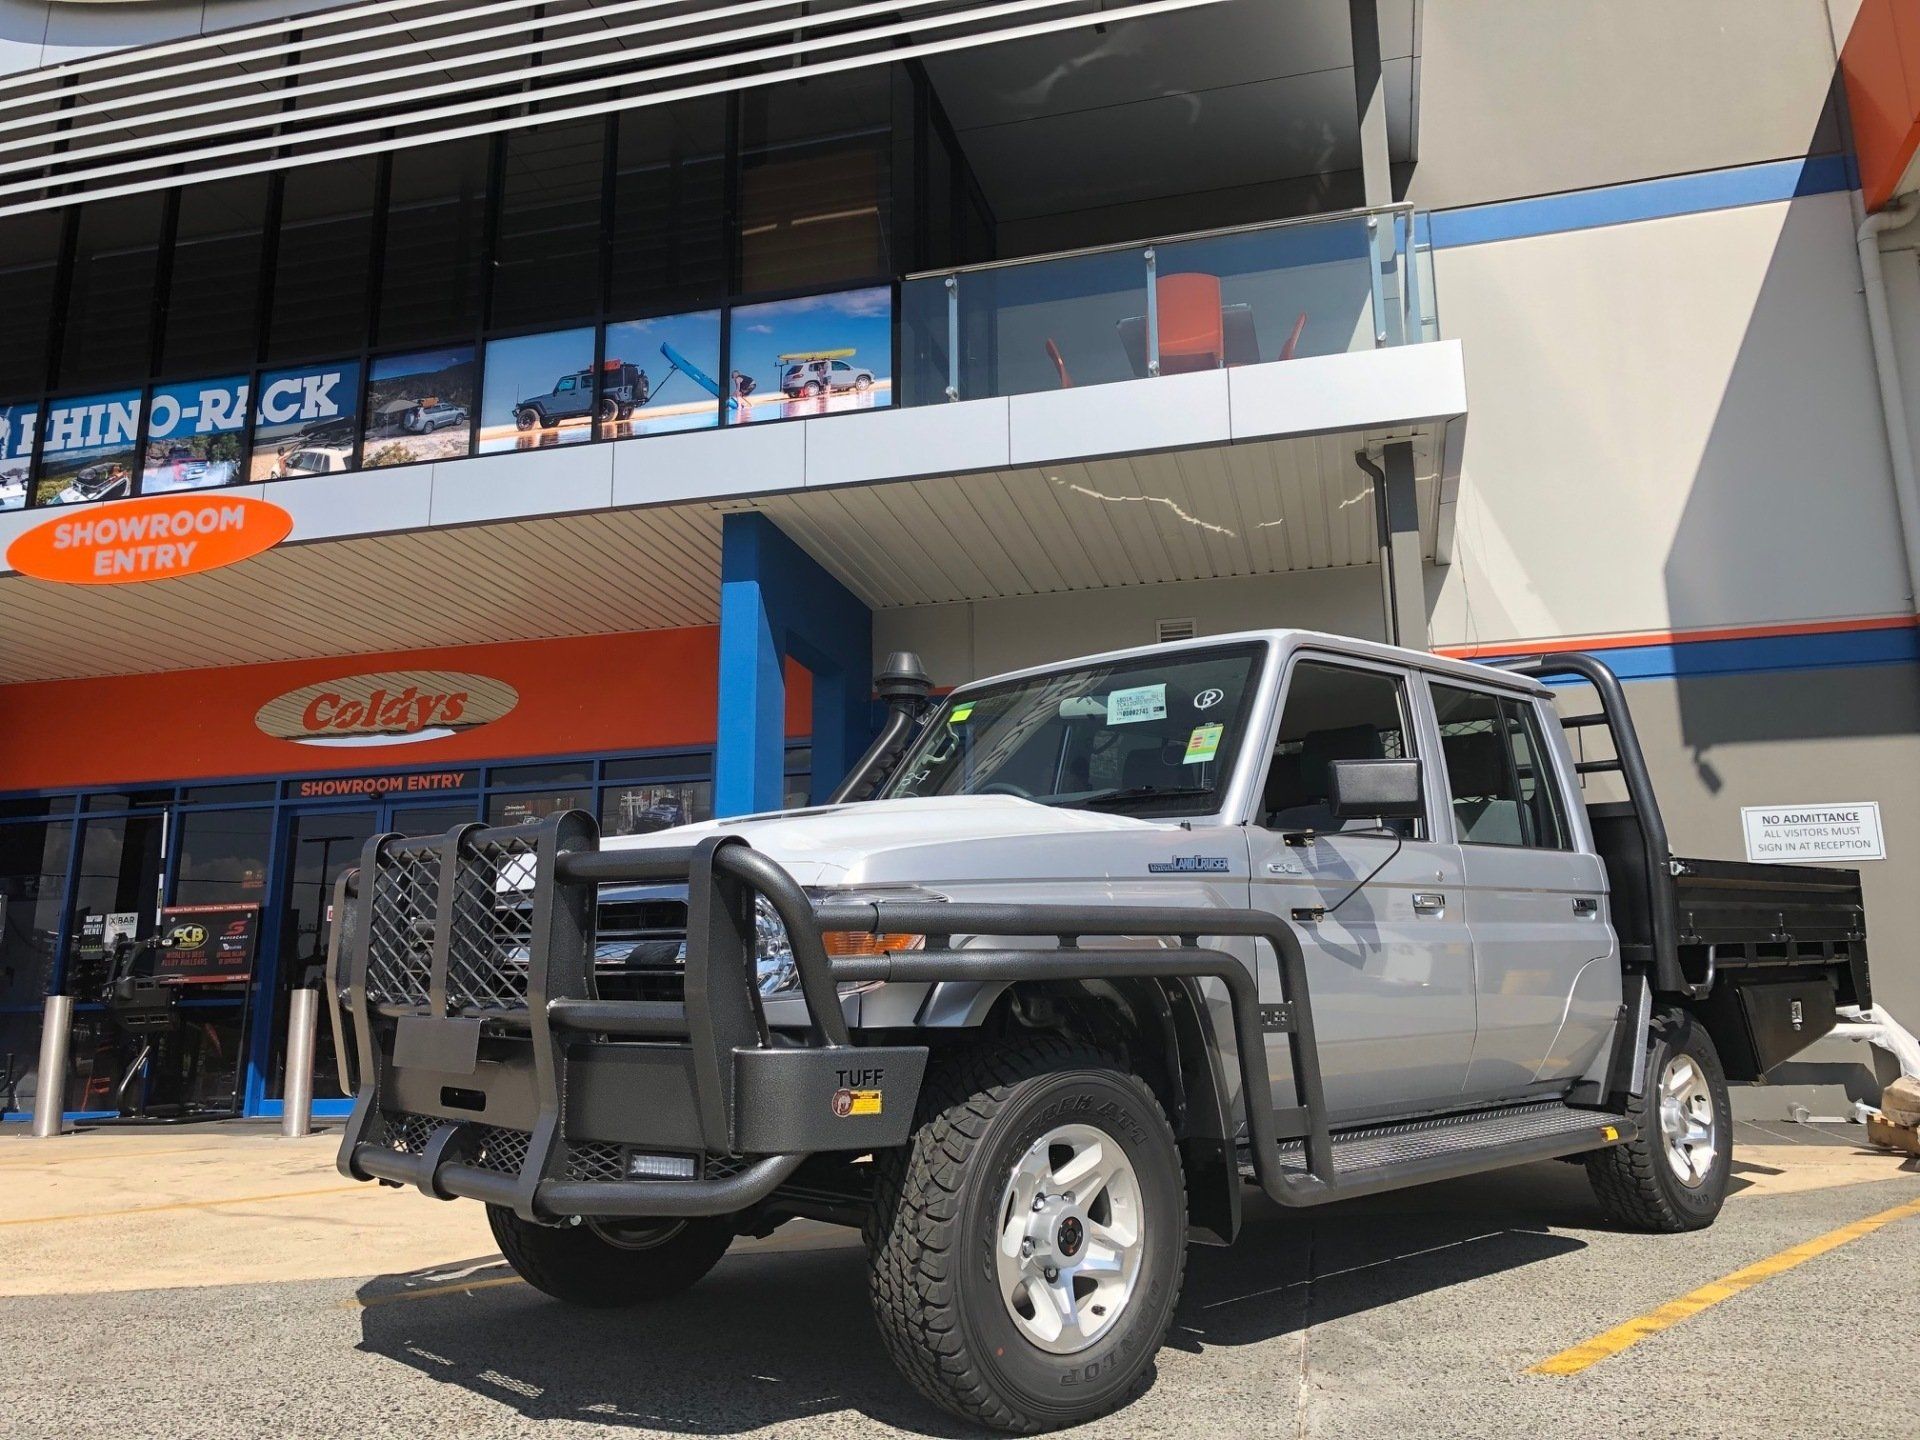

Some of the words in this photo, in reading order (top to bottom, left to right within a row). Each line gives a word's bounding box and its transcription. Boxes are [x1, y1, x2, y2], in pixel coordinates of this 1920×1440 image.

[16, 374, 341, 455] RHINO-RACK
[53, 505, 245, 549] SHOWROOM
[93, 541, 198, 576] ENTRY
[302, 686, 468, 733] Coldys
[301, 777, 404, 797] SHOWROOM
[407, 773, 464, 792] ENTRY
[1762, 814, 1780, 825] NO
[1783, 812, 1859, 824] ADMITTANCE
[1764, 829, 1782, 838] ALL
[1785, 827, 1829, 838] VISITORS
[1831, 826, 1861, 836] MUST
[1758, 843, 1783, 852] SIGN
[1785, 842, 1796, 851] IN
[1799, 841, 1811, 850] AT
[1814, 840, 1871, 850] RECEPTION
[836, 1069, 884, 1087] TUFF
